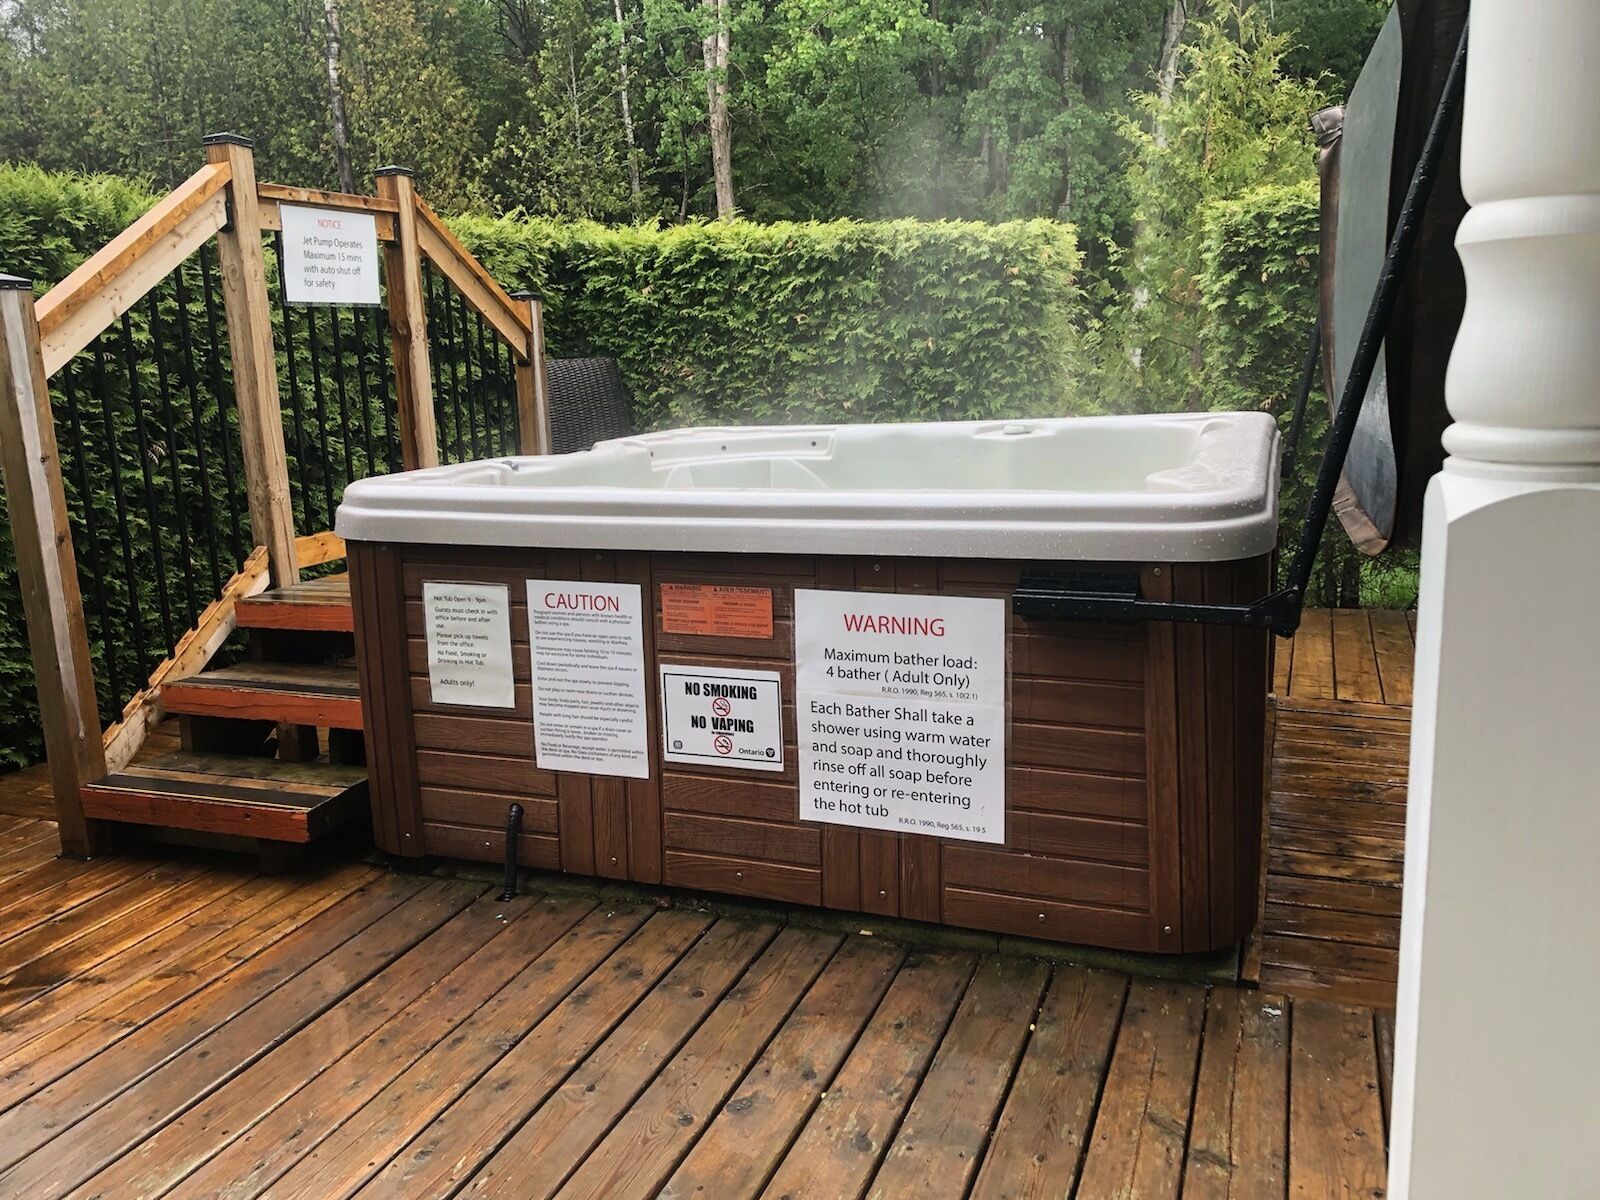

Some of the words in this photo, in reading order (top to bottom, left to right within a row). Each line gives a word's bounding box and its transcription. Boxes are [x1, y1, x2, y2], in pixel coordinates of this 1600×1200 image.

[318, 219, 342, 229] NOTICE
[302, 236, 312, 245] Jet
[314, 237, 332, 248] Pump
[334, 239, 362, 249] Operates
[304, 250, 336, 260] Maximum
[304, 278, 314, 287] for
[316, 278, 335, 289] safety
[544, 593, 619, 612] CAUTION
[843, 614, 945, 637] WARNING
[824, 648, 889, 663] Maximum
[894, 652, 939, 667] bather
[943, 655, 978, 670] load:
[826, 666, 834, 677] 4
[837, 666, 881, 681] bather
[933, 673, 970, 689] Only)
[685, 681, 700, 696] NO
[703, 683, 757, 700] SMOKING
[902, 688, 919, 696] 1990,
[920, 690, 933, 699] Reg
[934, 690, 948, 698] 565,
[956, 691, 978, 700] 10(2.1)
[810, 700, 842, 716] Each
[846, 704, 891, 719] Bather
[894, 707, 928, 722] Shall
[932, 711, 962, 725] take
[966, 716, 974, 726] a
[691, 715, 706, 729] NO
[712, 717, 754, 733] VAPING
[811, 721, 860, 736] shower
[864, 727, 901, 743] using
[905, 730, 945, 744] warm
[950, 734, 991, 748] water
[739, 747, 764, 756] Ontario
[812, 741, 837, 754] and
[841, 744, 873, 760] soap
[876, 748, 902, 760] and
[906, 749, 987, 771] thoroughly
[813, 760, 844, 773] rinse
[848, 763, 867, 776] off
[870, 765, 885, 778] all
[889, 769, 922, 784] soap
[926, 769, 972, 787] before
[813, 779, 869, 798] entering
[873, 785, 888, 798] or
[891, 787, 971, 810] re-entering
[814, 797, 836, 811] the
[839, 800, 863, 814] hot
[866, 804, 889, 817] tub
[918, 819, 935, 828] 1990,
[937, 821, 949, 831] Reg
[951, 822, 964, 831] 565,
